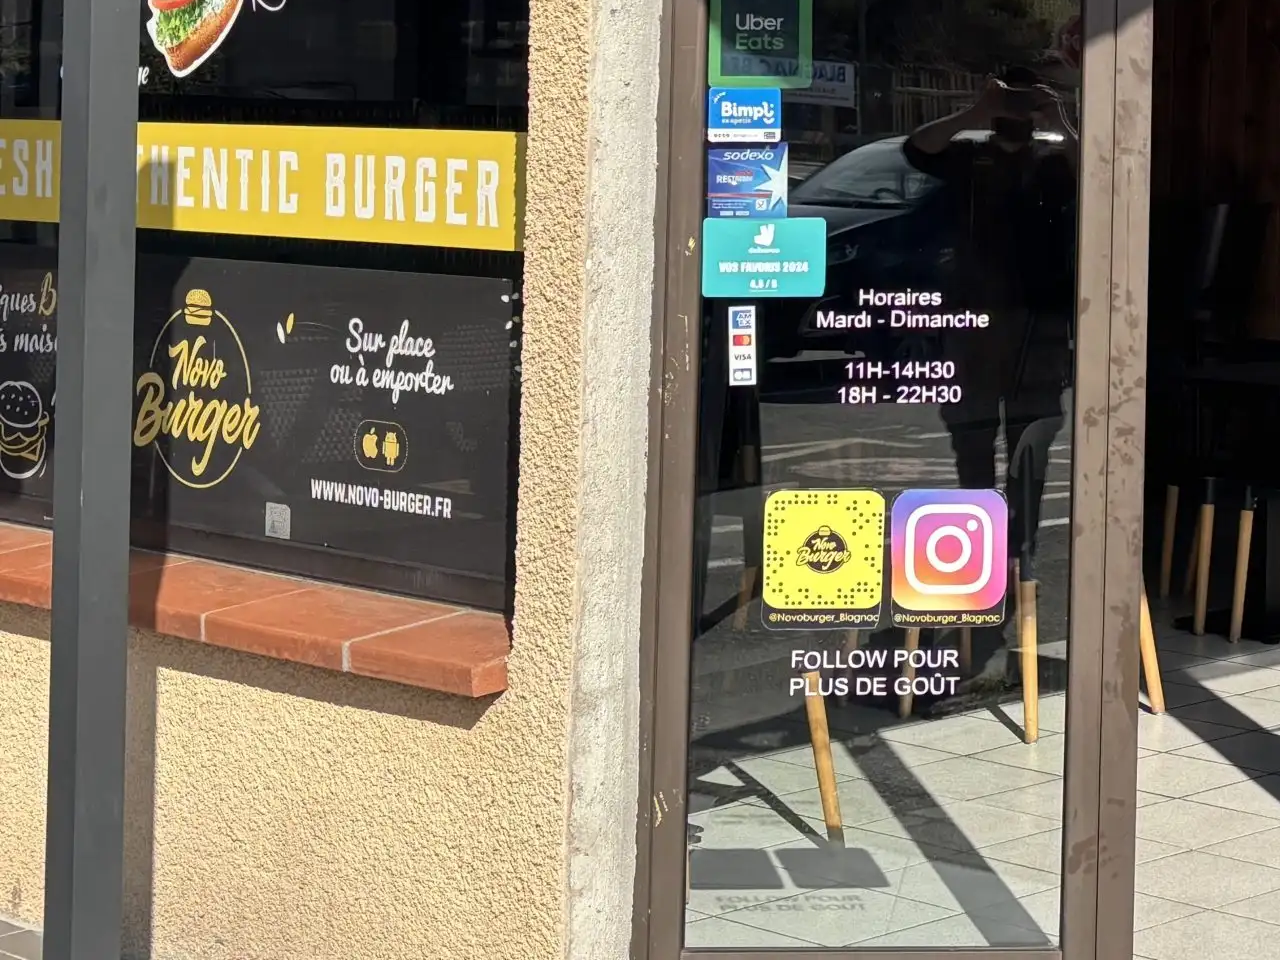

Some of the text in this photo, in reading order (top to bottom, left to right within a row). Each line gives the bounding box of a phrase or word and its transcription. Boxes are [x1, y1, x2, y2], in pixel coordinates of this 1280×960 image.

[735, 12, 785, 31] Uber
[735, 33, 785, 51] Eats
[722, 148, 775, 161] sodexo
[137, 144, 501, 229] HENTIC BURGER
[782, 261, 809, 273] 2024
[858, 288, 943, 306] Horaires
[816, 310, 872, 328] Mardi
[890, 309, 990, 329] Dimanche
[346, 317, 436, 368] Sur place
[168, 335, 228, 391] Novo
[734, 353, 752, 361] VISA
[330, 354, 455, 405] ou à emporter
[844, 360, 956, 380] 11H-14H30
[837, 386, 877, 404] 18H
[896, 385, 963, 404] 22H30
[133, 371, 261, 477] Burger
[310, 478, 452, 519] WWW.NOVO-BURGER.FR
[811, 537, 837, 551] Novo
[796, 546, 852, 571] Burger
[768, 612, 880, 624] @Novoburger_Blagnac
[894, 612, 1001, 625] @Novoburger_Blagnac
[791, 648, 960, 670] FOLLOW POUR
[789, 673, 961, 697] PLUS DE GOÛT
